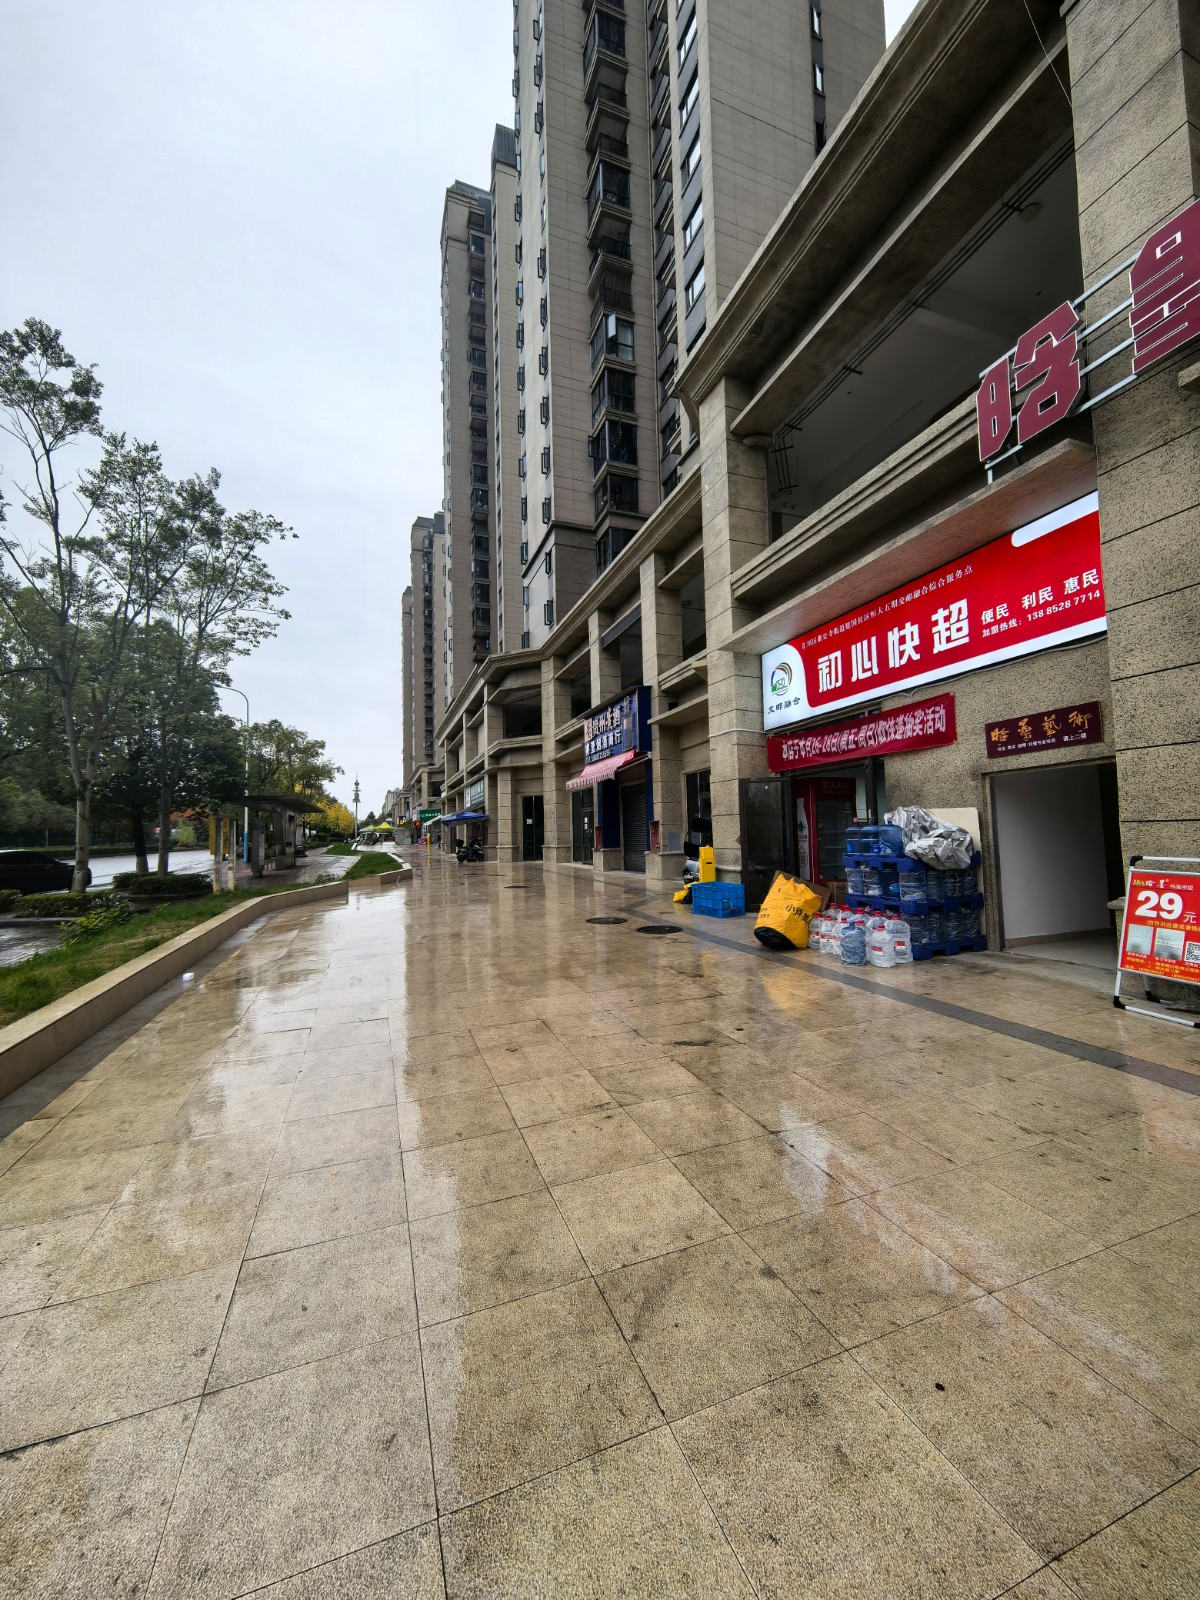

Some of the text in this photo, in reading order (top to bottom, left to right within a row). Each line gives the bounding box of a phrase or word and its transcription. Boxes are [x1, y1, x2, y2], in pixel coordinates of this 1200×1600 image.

[981, 568, 1099, 625] 便民 利民 惠民
[1027, 610, 1044, 622] 138
[1046, 600, 1071, 615] 8528
[1074, 590, 1100, 606] 7714
[817, 598, 969, 693] 初心快超
[1134, 890, 1197, 924] 29 元
